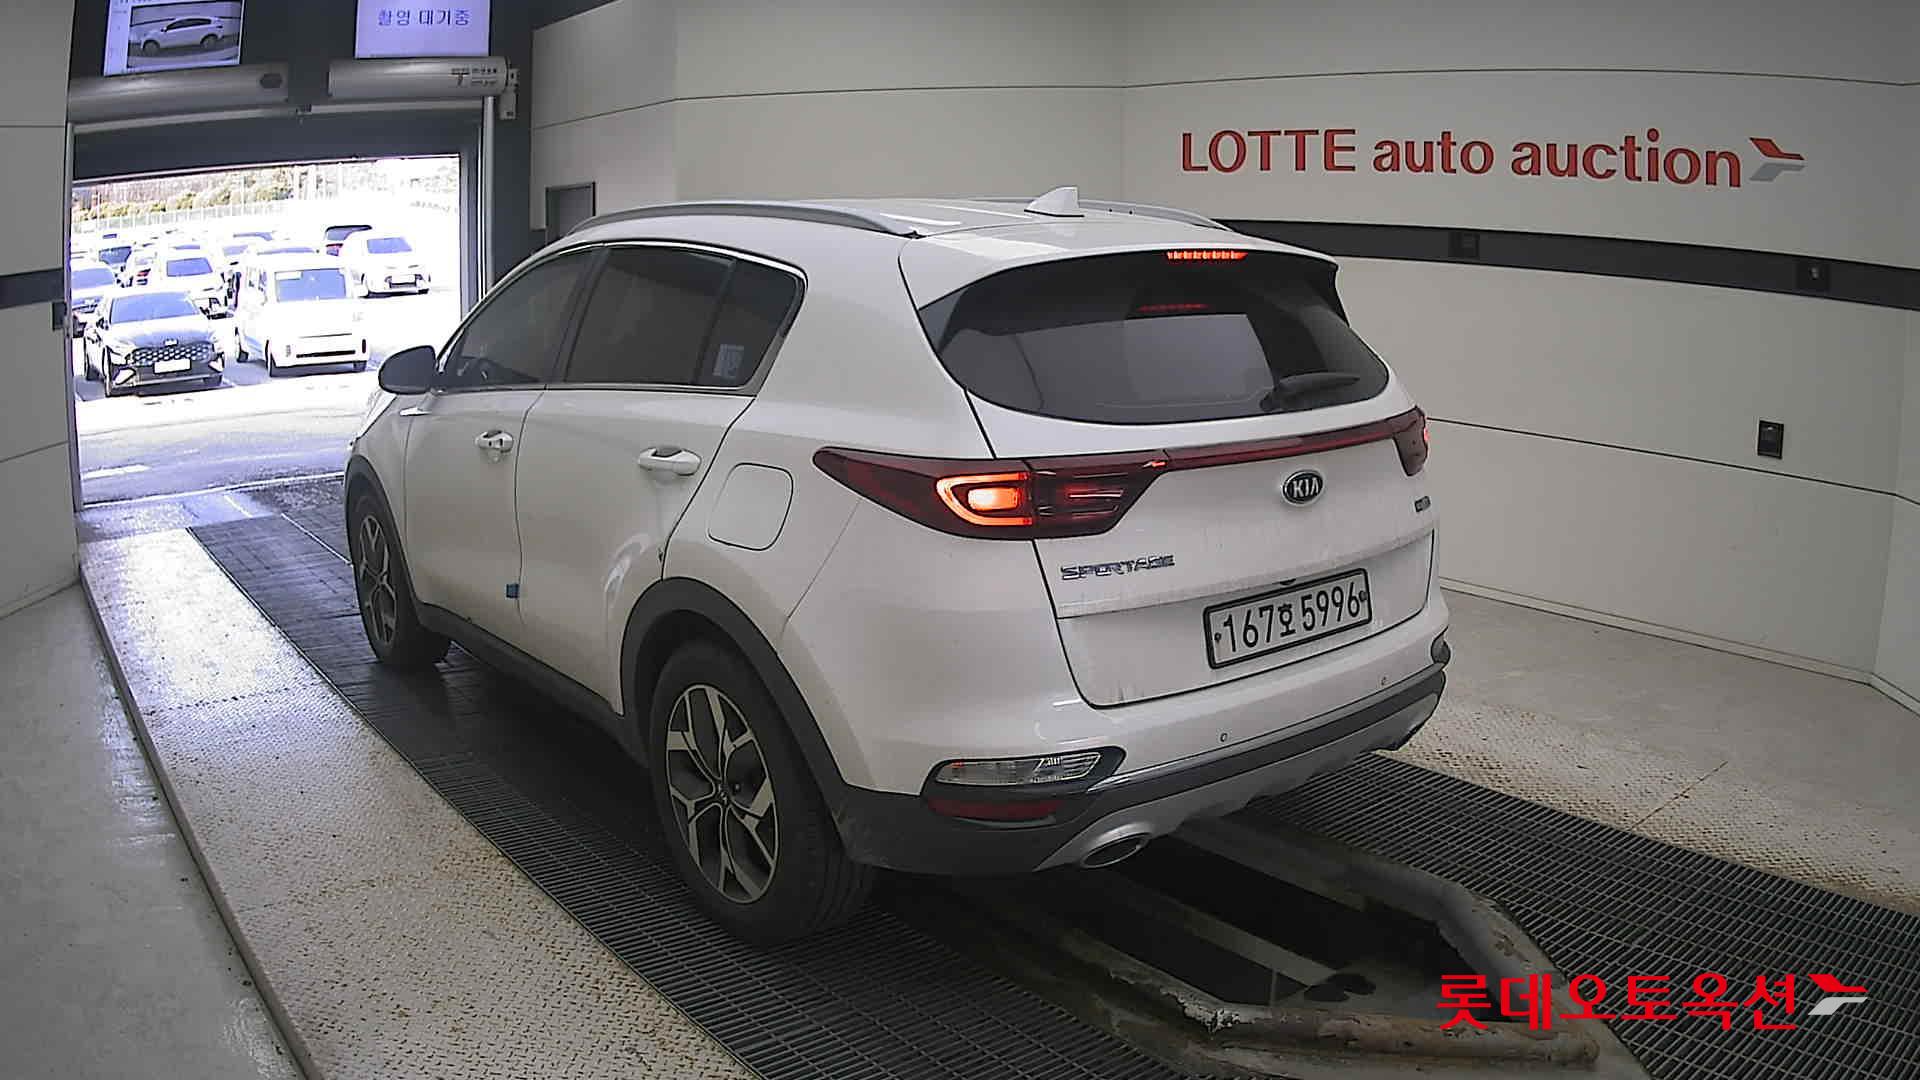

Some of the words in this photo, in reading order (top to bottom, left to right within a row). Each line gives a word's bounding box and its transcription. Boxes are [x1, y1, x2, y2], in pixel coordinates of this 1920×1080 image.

[419, 9, 469, 26] 대기중
[1181, 130, 1356, 174] LOTTE
[1373, 131, 1495, 176] auto
[1512, 129, 1741, 188] auction
[1292, 477, 1319, 498] KIA
[1060, 555, 1175, 580] SPORTAGE
